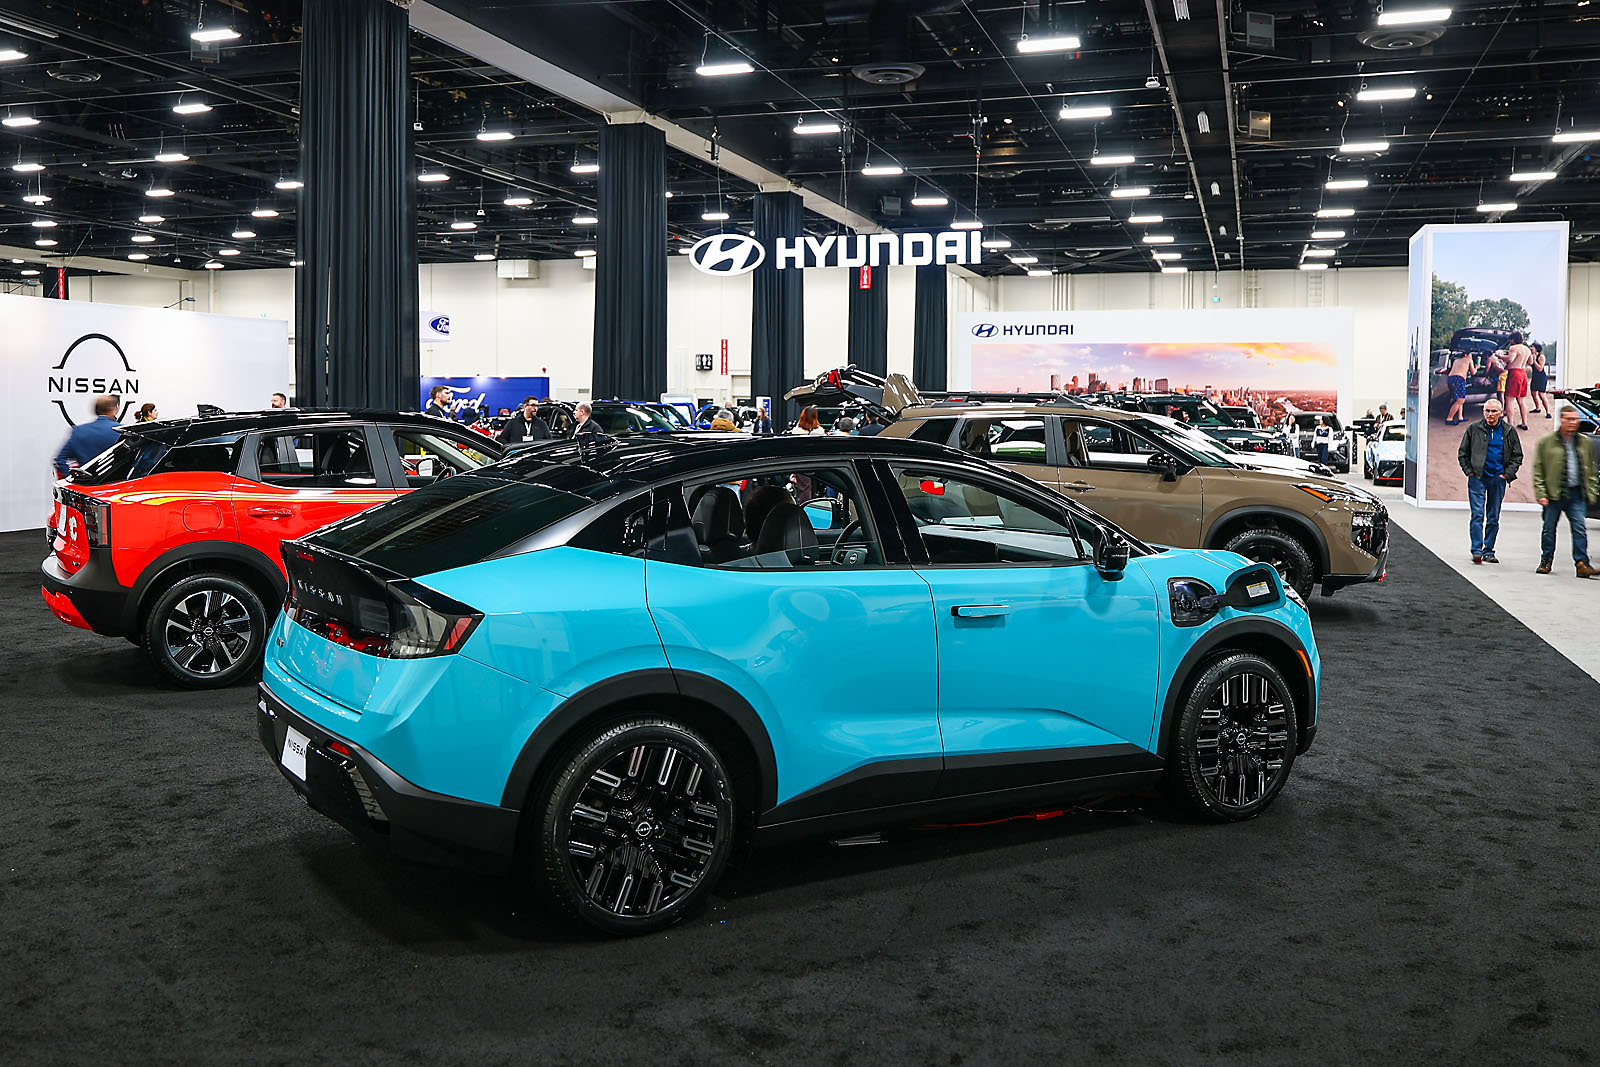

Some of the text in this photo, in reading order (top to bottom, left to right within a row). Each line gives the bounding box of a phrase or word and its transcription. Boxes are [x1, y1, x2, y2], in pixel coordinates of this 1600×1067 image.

[775, 230, 982, 270] HYUNDAI
[1003, 324, 1074, 336] HYUNDAI
[48, 376, 139, 394] NISSAN
